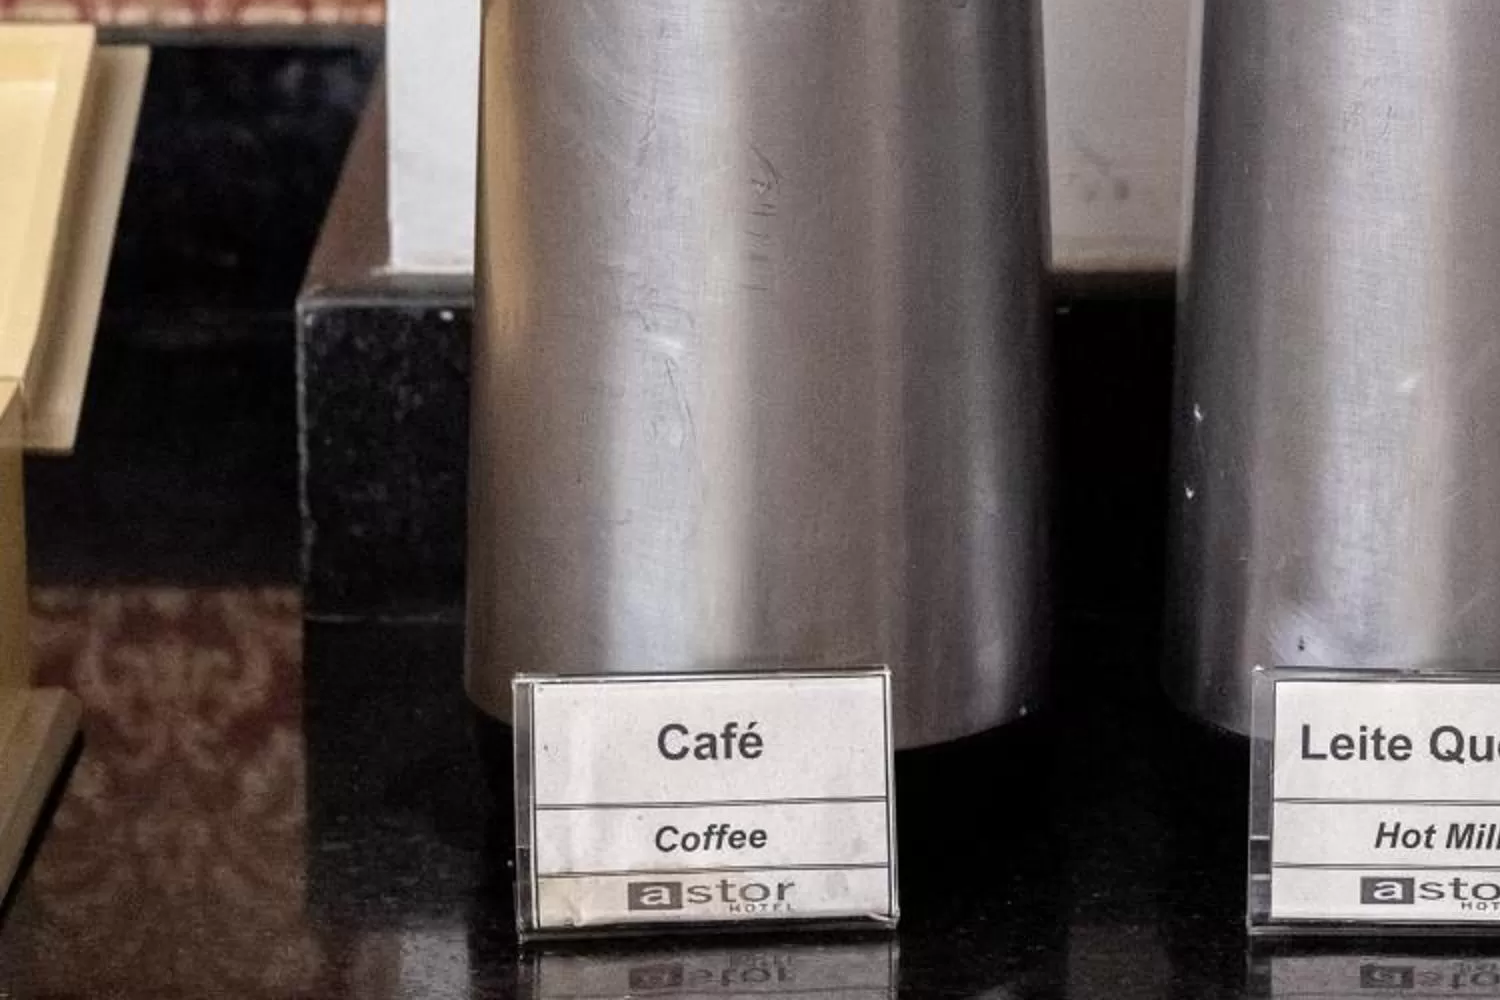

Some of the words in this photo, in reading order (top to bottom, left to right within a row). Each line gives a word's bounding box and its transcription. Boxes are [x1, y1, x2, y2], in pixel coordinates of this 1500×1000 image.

[657, 722, 764, 761] Café
[1301, 724, 1413, 761] Leite
[655, 823, 768, 852] Coffee
[1374, 822, 1436, 850] Hot
[628, 880, 796, 910] astor
[729, 903, 796, 913] HOTEL
